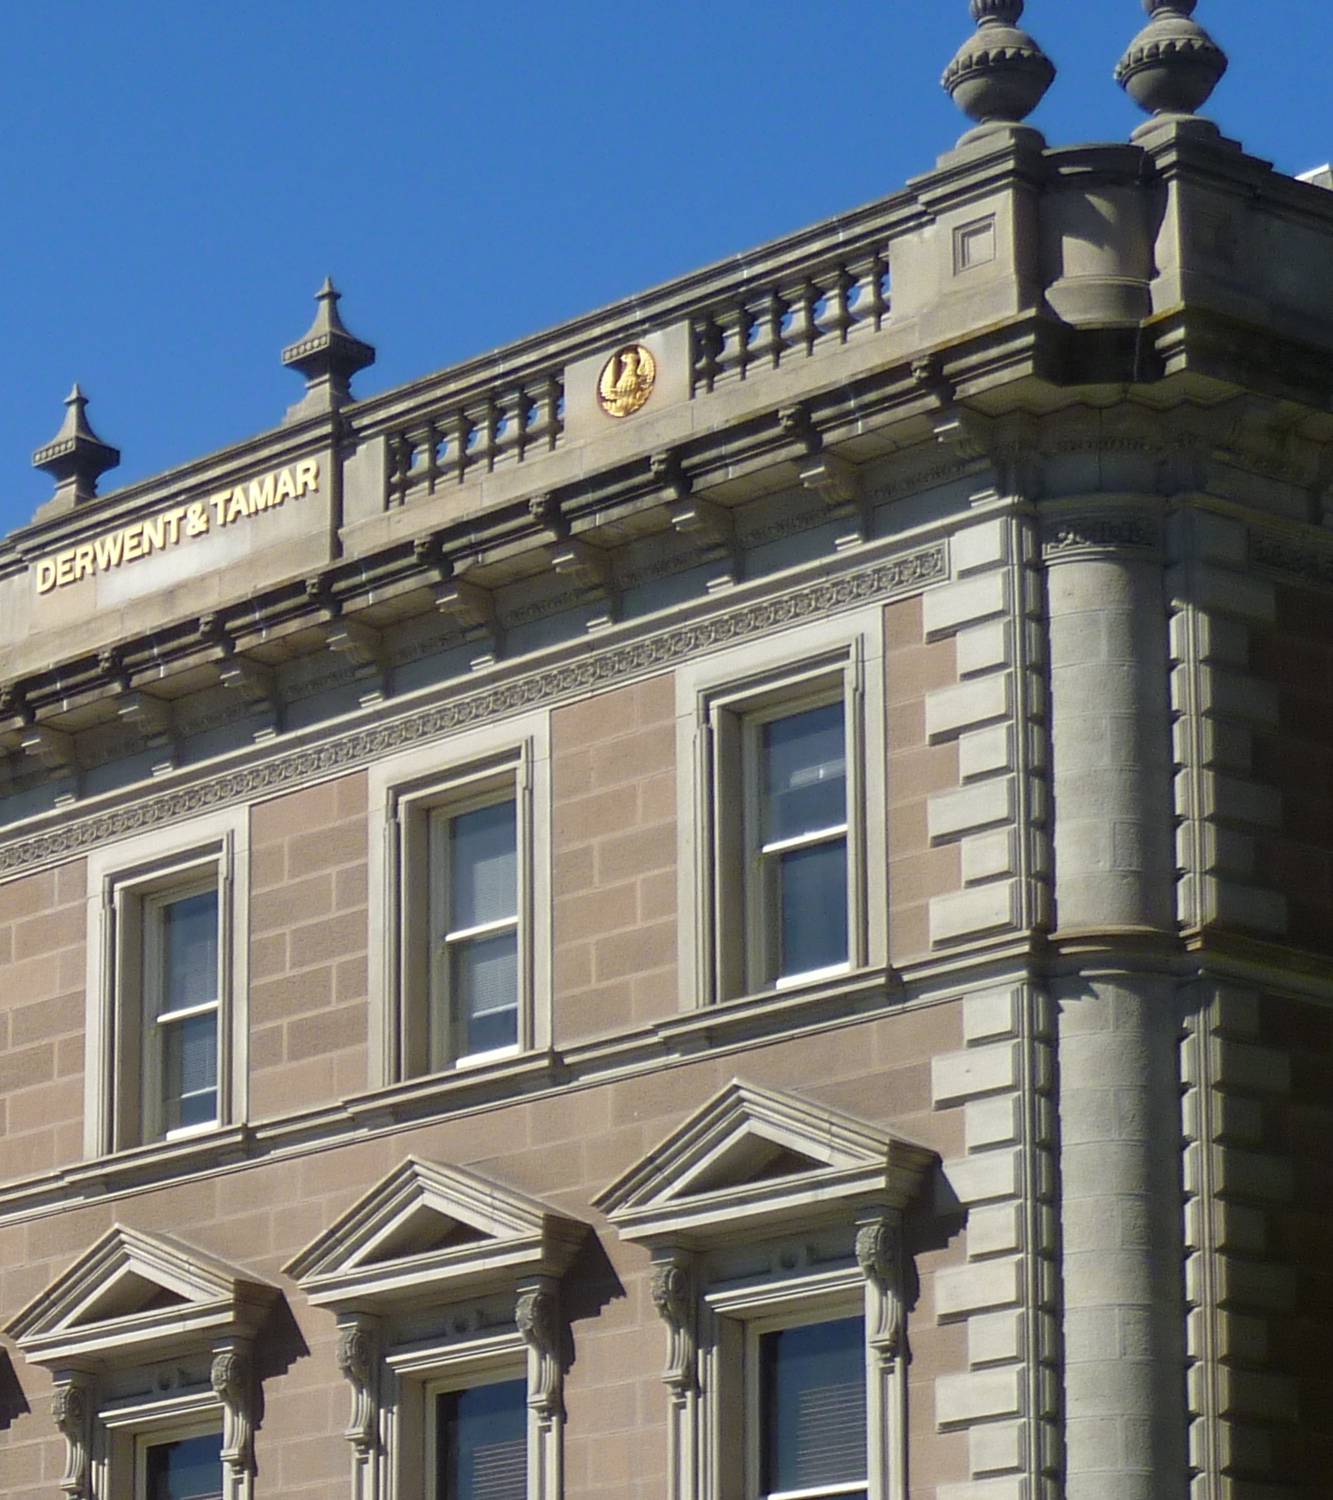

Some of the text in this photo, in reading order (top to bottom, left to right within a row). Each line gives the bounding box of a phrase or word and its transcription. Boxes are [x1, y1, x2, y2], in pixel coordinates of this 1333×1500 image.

[36, 459, 320, 594] DERWENT & TAMAR
